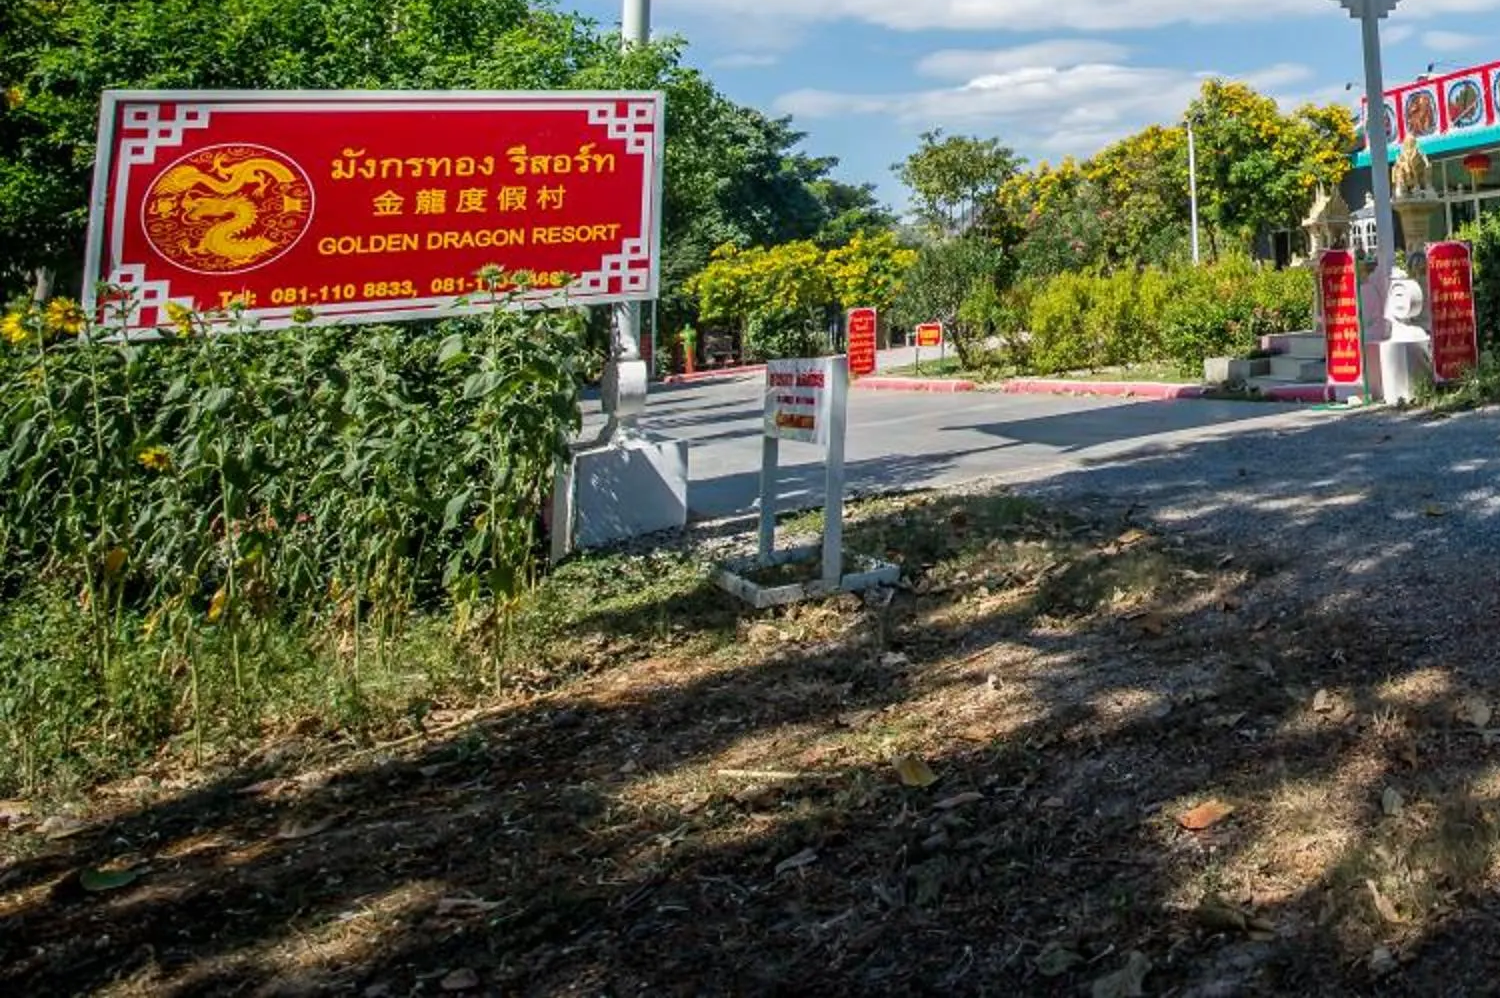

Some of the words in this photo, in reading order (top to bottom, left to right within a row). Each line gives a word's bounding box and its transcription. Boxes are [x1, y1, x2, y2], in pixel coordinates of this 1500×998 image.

[331, 147, 495, 180] มังกรทอง
[506, 142, 615, 176] รีสอร์ท
[372, 185, 566, 217] 金龍度假村
[318, 233, 418, 256] GOLDEN
[427, 228, 525, 250] DRAGON
[531, 223, 620, 244] RESORT
[271, 283, 356, 303] 081-110
